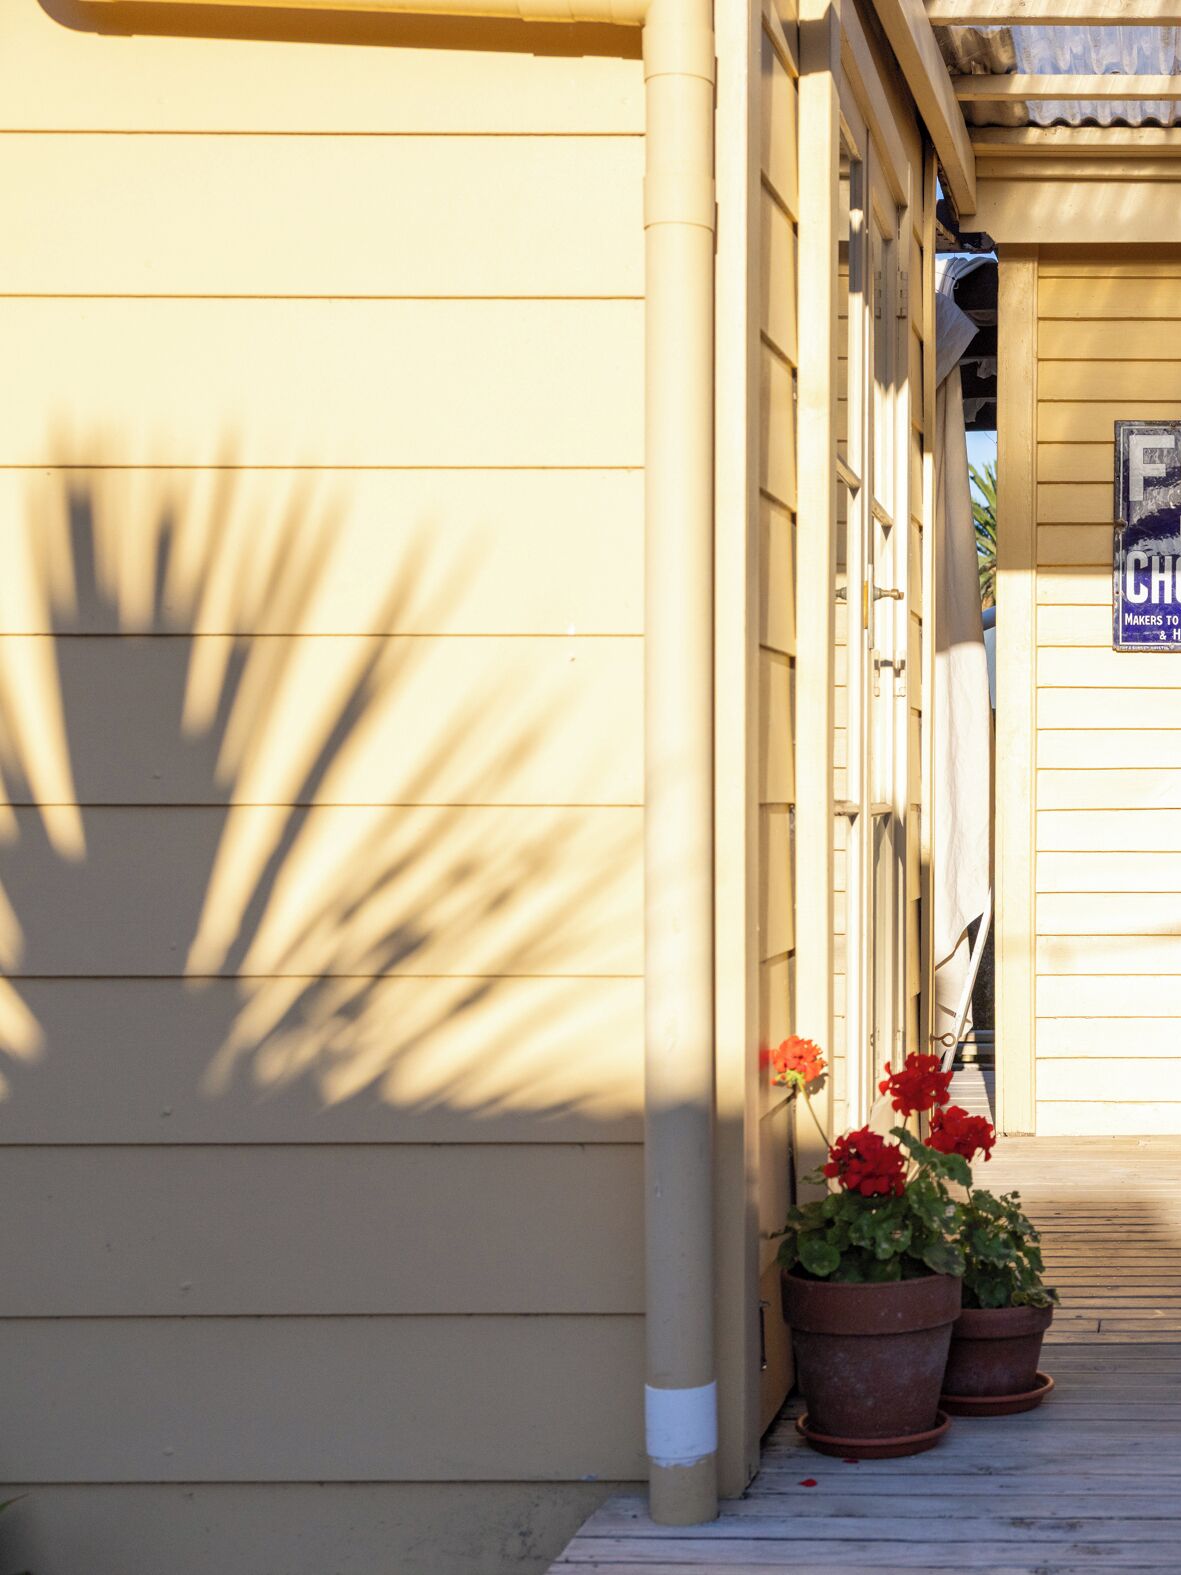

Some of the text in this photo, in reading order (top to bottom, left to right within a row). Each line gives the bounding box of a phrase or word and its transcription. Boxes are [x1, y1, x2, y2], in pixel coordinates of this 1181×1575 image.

[1125, 613, 1163, 626] MAKERS
[1166, 615, 1179, 625] TO
[1159, 630, 1167, 640] &
